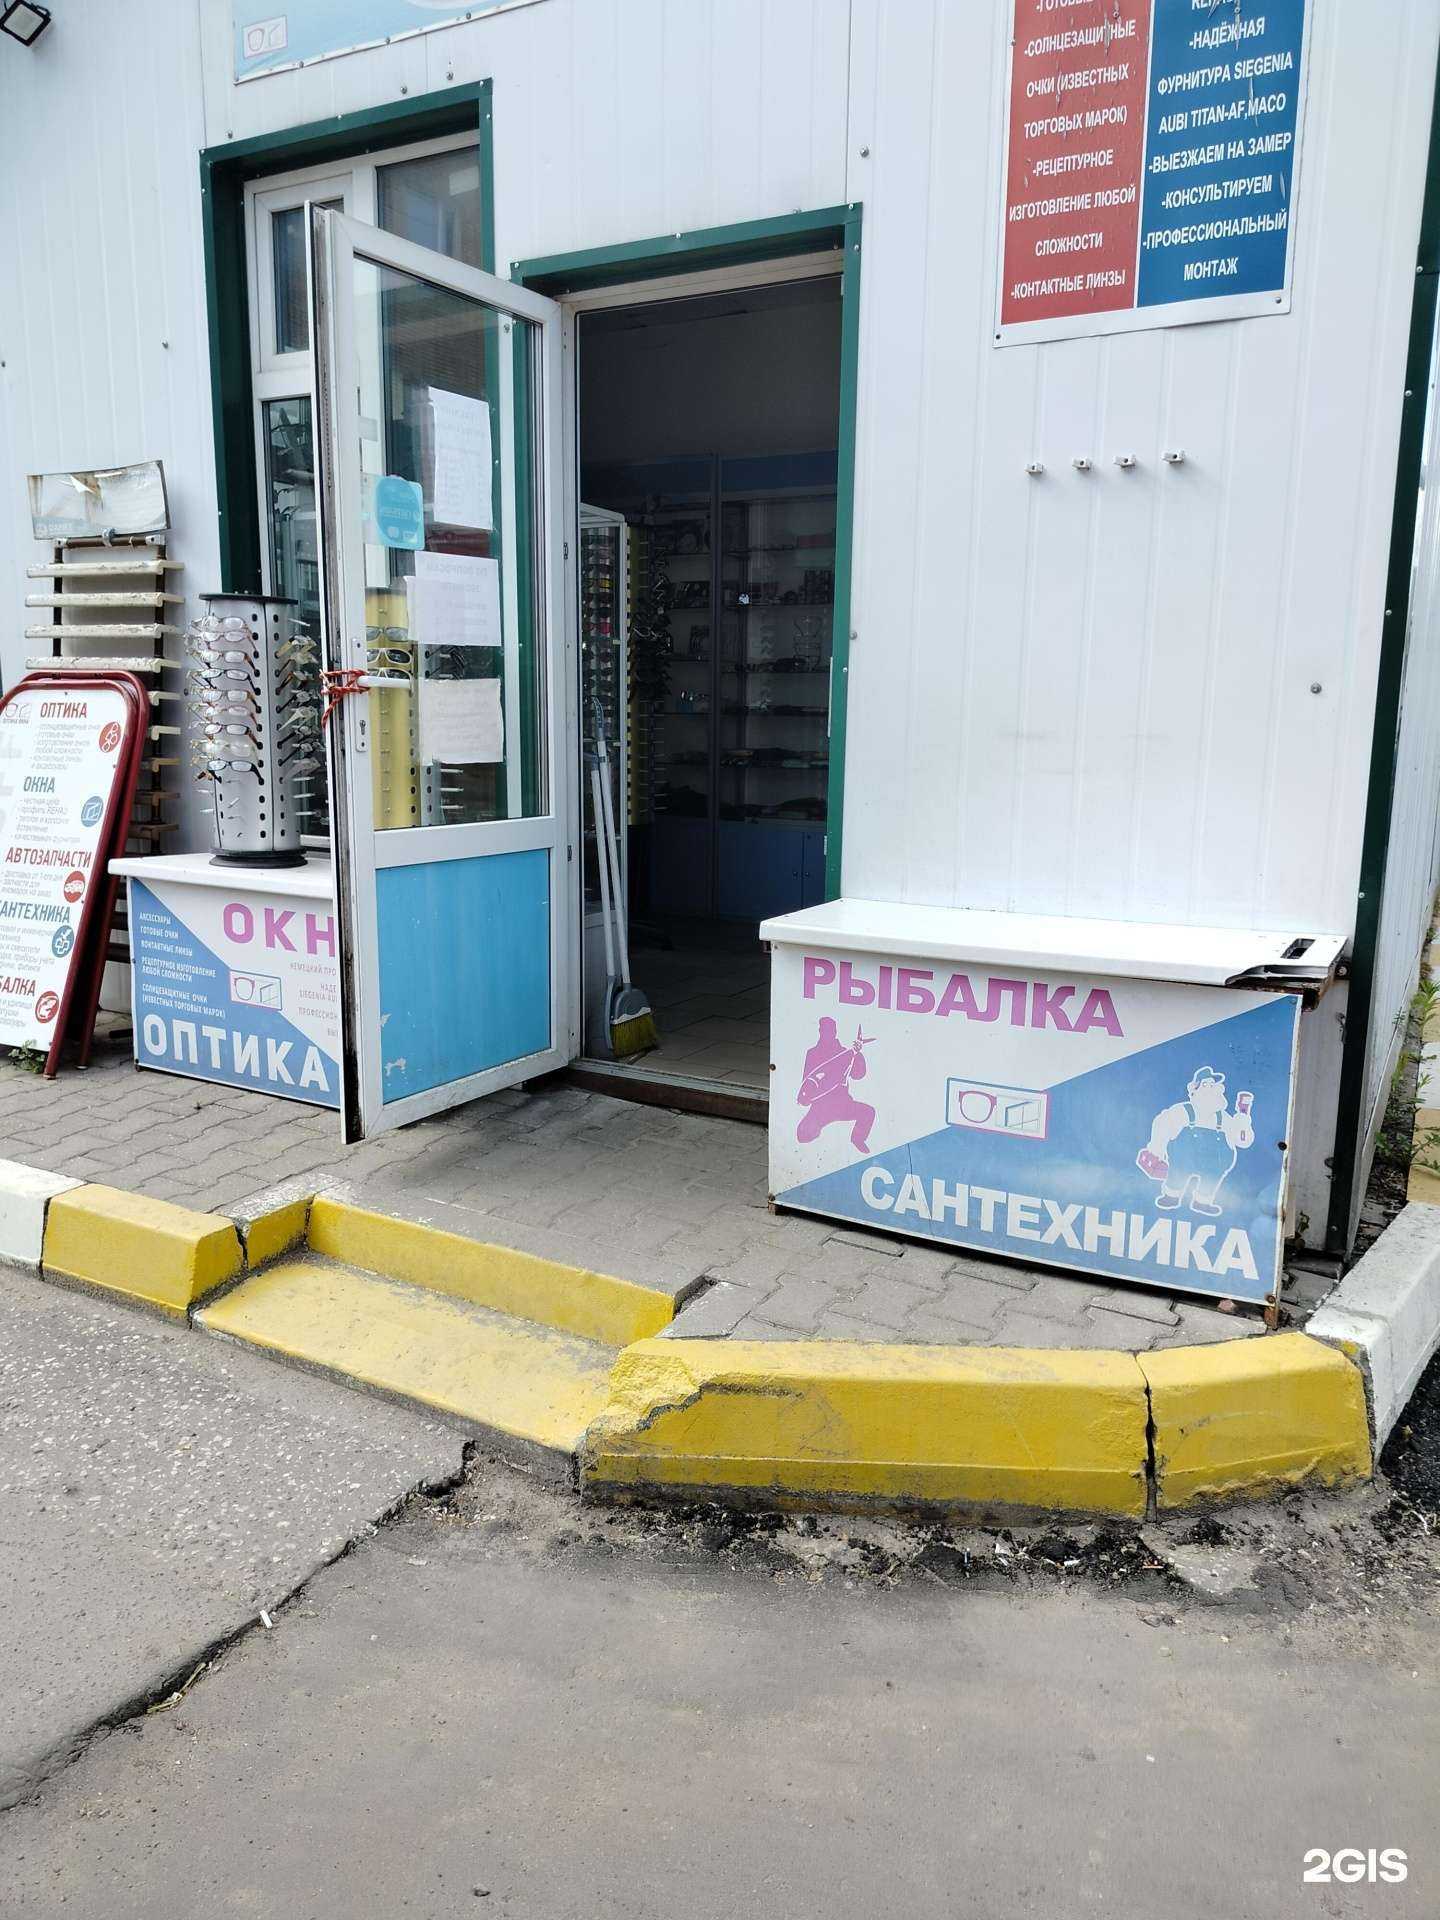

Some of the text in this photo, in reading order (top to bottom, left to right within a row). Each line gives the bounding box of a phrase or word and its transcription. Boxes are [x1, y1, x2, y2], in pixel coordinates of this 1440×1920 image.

[1026, 63, 1129, 98] ОЧКИ (ИЗВЕСТНЫХ
[1157, 51, 1293, 95] ФУРНИТУРА SIEGENIA
[1024, 105, 1127, 139] ТОРГОВЫХ МАРОК)
[1159, 114, 1188, 134] AUBI
[1032, 149, 1113, 177] -РЕЦЕПТУРНОЕ
[1148, 132, 1292, 174] -ВЫЕЗЖАЕМ НА ЗАМЕР
[1009, 184, 1136, 222] ИЗГОТОВЛЕНИЕ ЛЮБОЙ
[1161, 175, 1272, 209] -КОНСУЛЬТИРУЕМ
[1035, 232, 1103, 257] СЛОЖНОСТИ
[1142, 208, 1287, 250] -ПРОФЕССИОНАЛЬНЫЙ
[1011, 269, 1125, 299] -КОНТАКТНЫЕ ЛИНЗЫ
[1184, 257, 1238, 281] МОНТАЖ
[40, 702, 87, 718] ОПТИКА
[23, 776, 56, 793] ОКНА
[5, 847, 92, 868] АВТОЗАПЧАСТИ
[0, 900, 71, 923] АНТЕХНИКА
[802, 956, 1124, 1038] РЫБАЛКА
[143, 1014, 330, 1092] ОПТИКА
[860, 1166, 1259, 1281] САНТЕХНИКА
